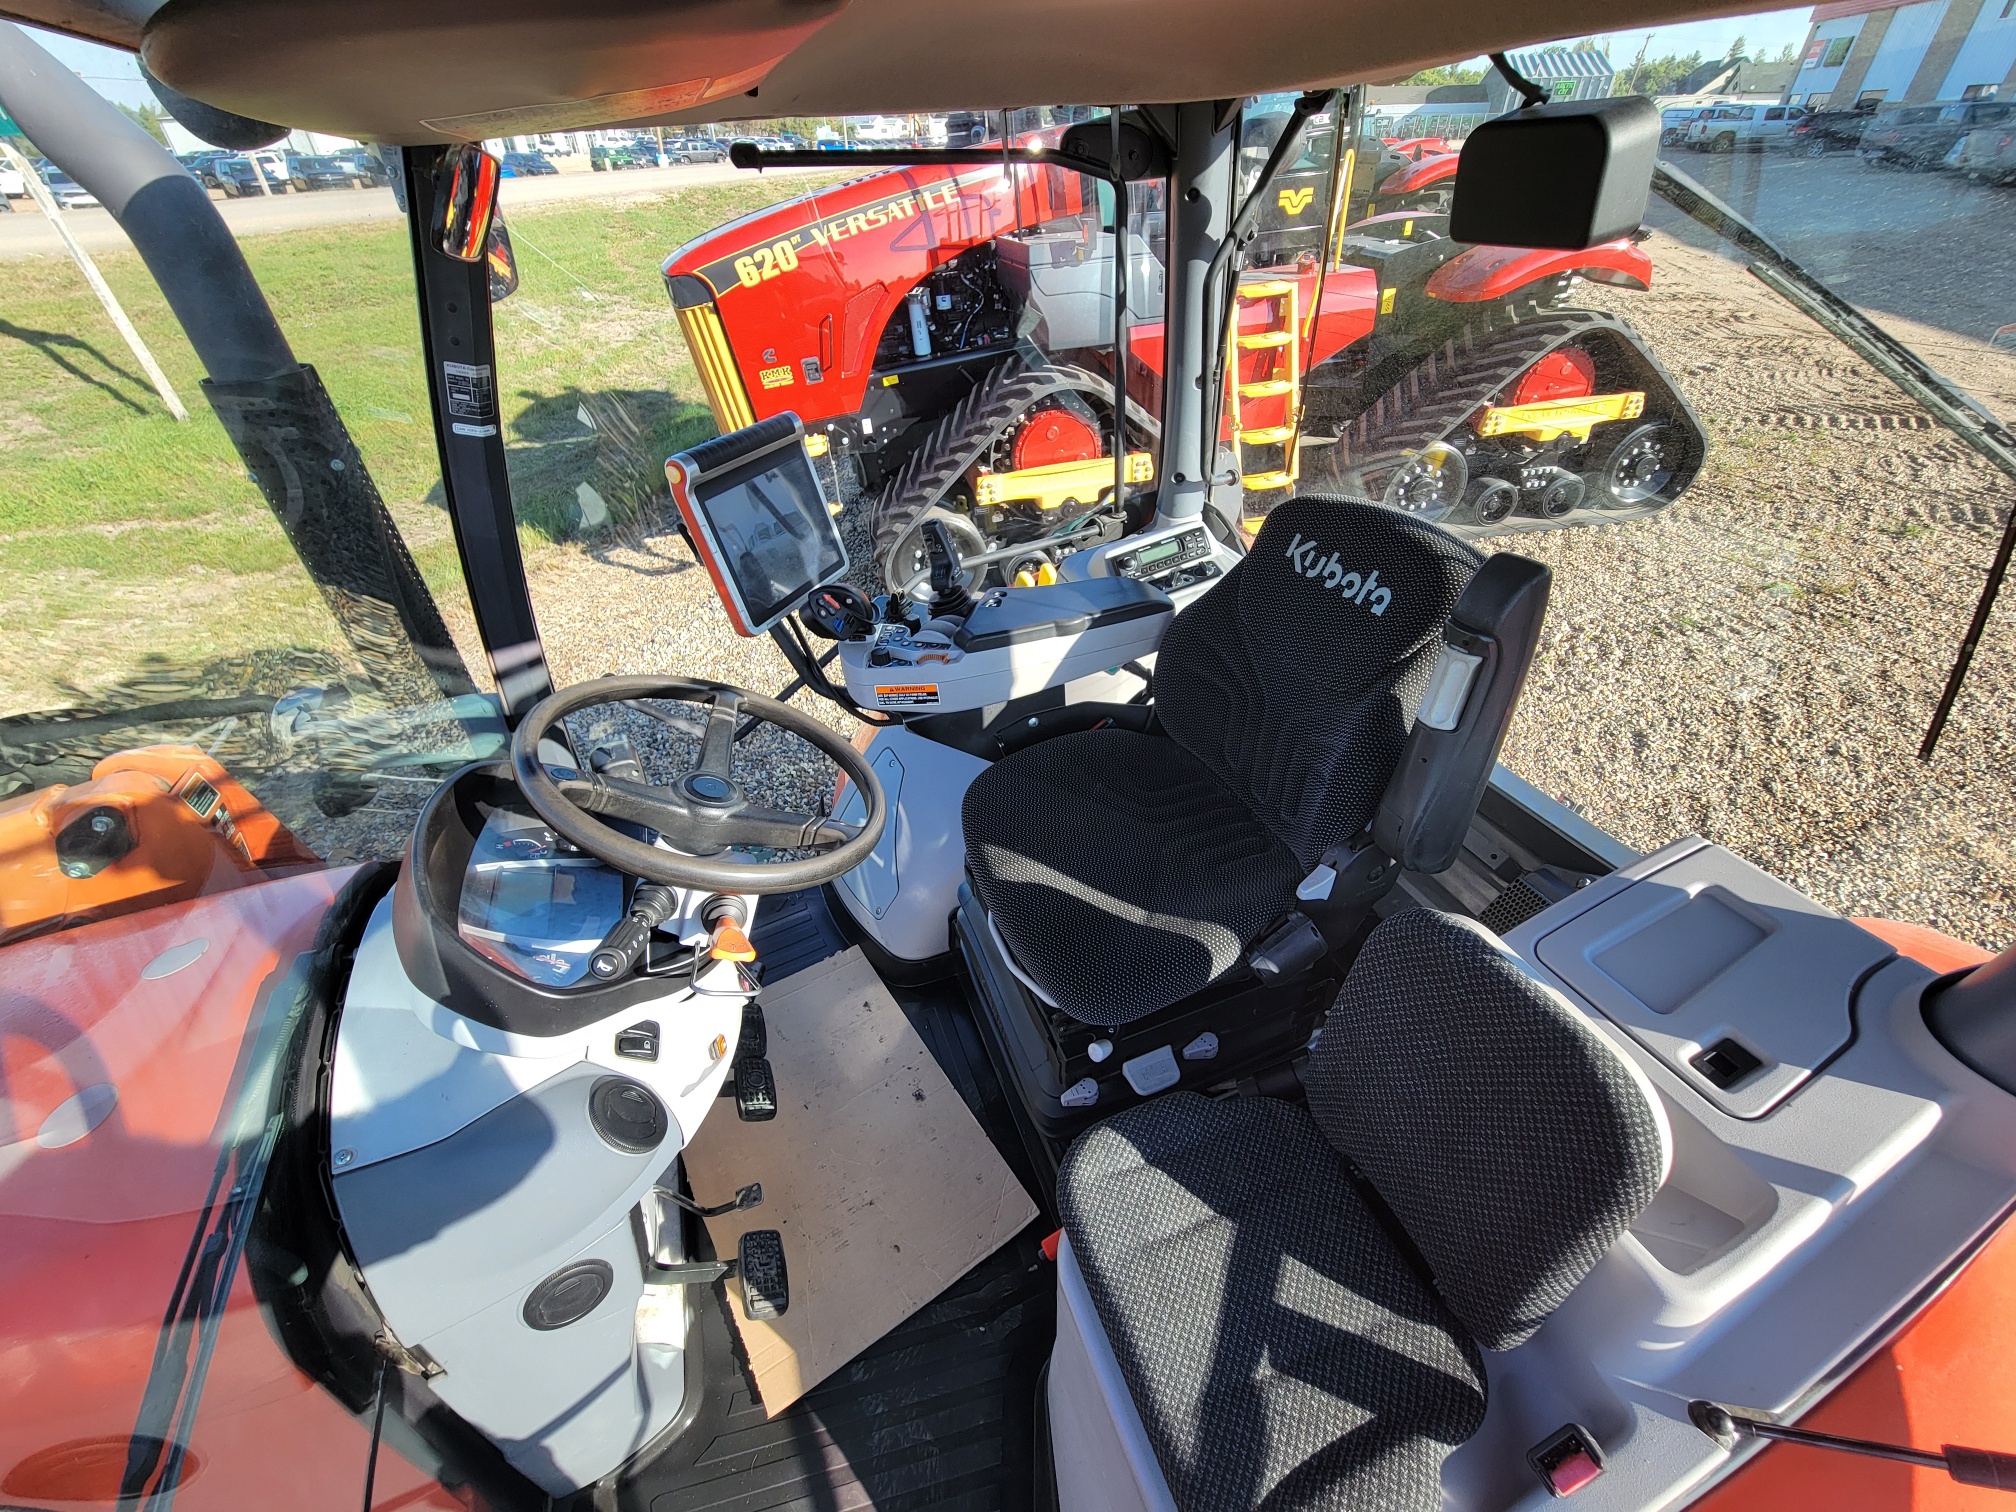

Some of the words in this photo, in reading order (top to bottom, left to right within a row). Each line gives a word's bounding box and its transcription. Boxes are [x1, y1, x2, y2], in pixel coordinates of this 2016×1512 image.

[734, 239, 799, 288] 620
[810, 183, 961, 246] VERSATILE
[1285, 533, 1392, 617] Kubota
